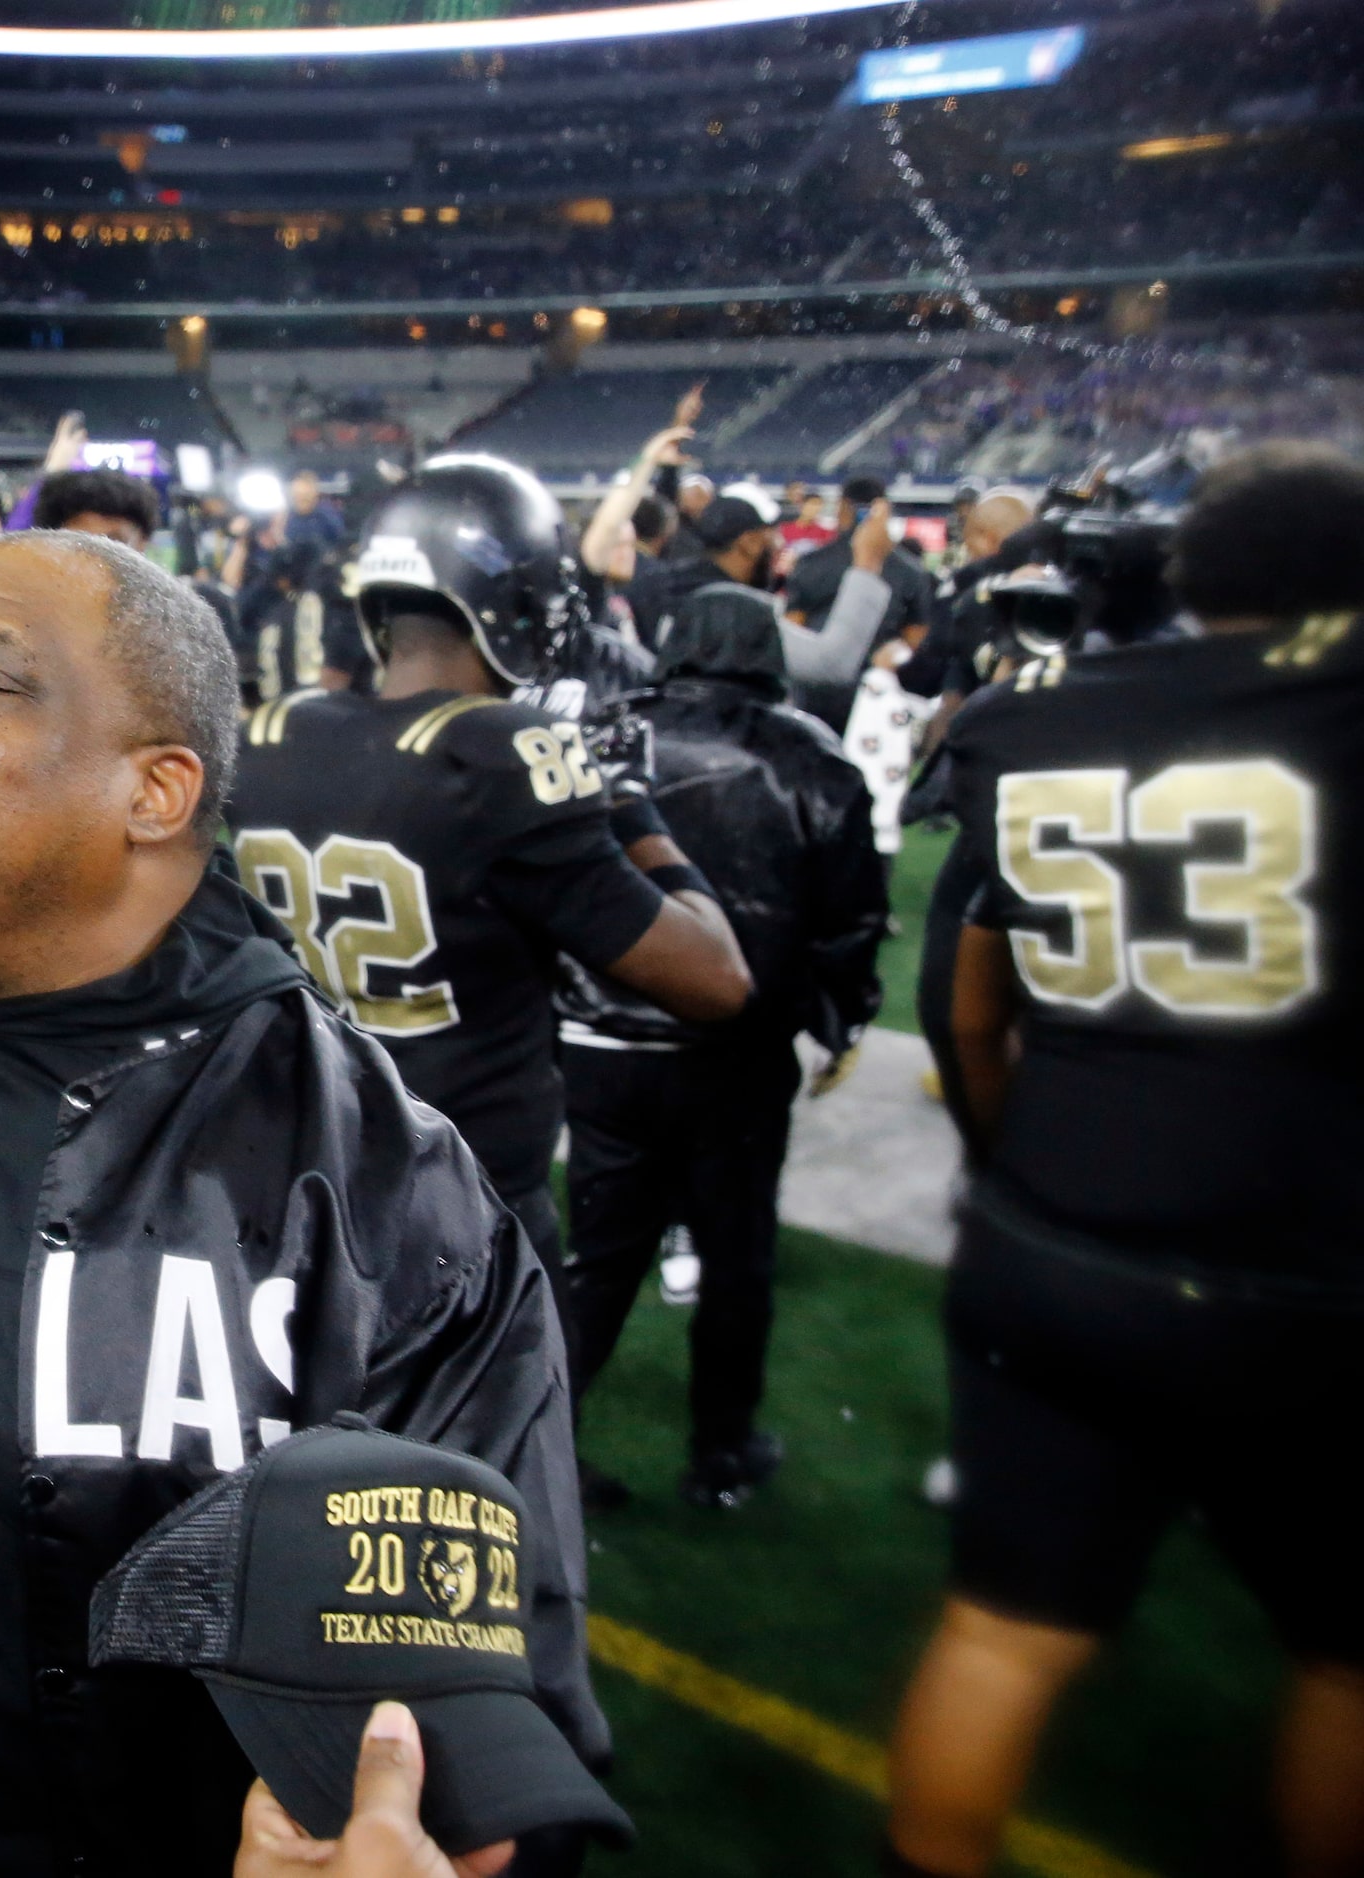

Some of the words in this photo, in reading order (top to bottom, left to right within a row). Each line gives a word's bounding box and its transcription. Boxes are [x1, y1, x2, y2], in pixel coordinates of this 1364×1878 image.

[513, 721, 603, 805] 82
[996, 760, 1317, 1016] 53
[236, 829, 461, 1037] 82
[326, 1486, 423, 1527] SOUTH
[427, 1487, 478, 1530] OAK
[344, 1530, 407, 1596] 20
[486, 1545, 520, 1611] 22
[320, 1612, 395, 1645] TEXAS
[396, 1614, 461, 1648] STATE
